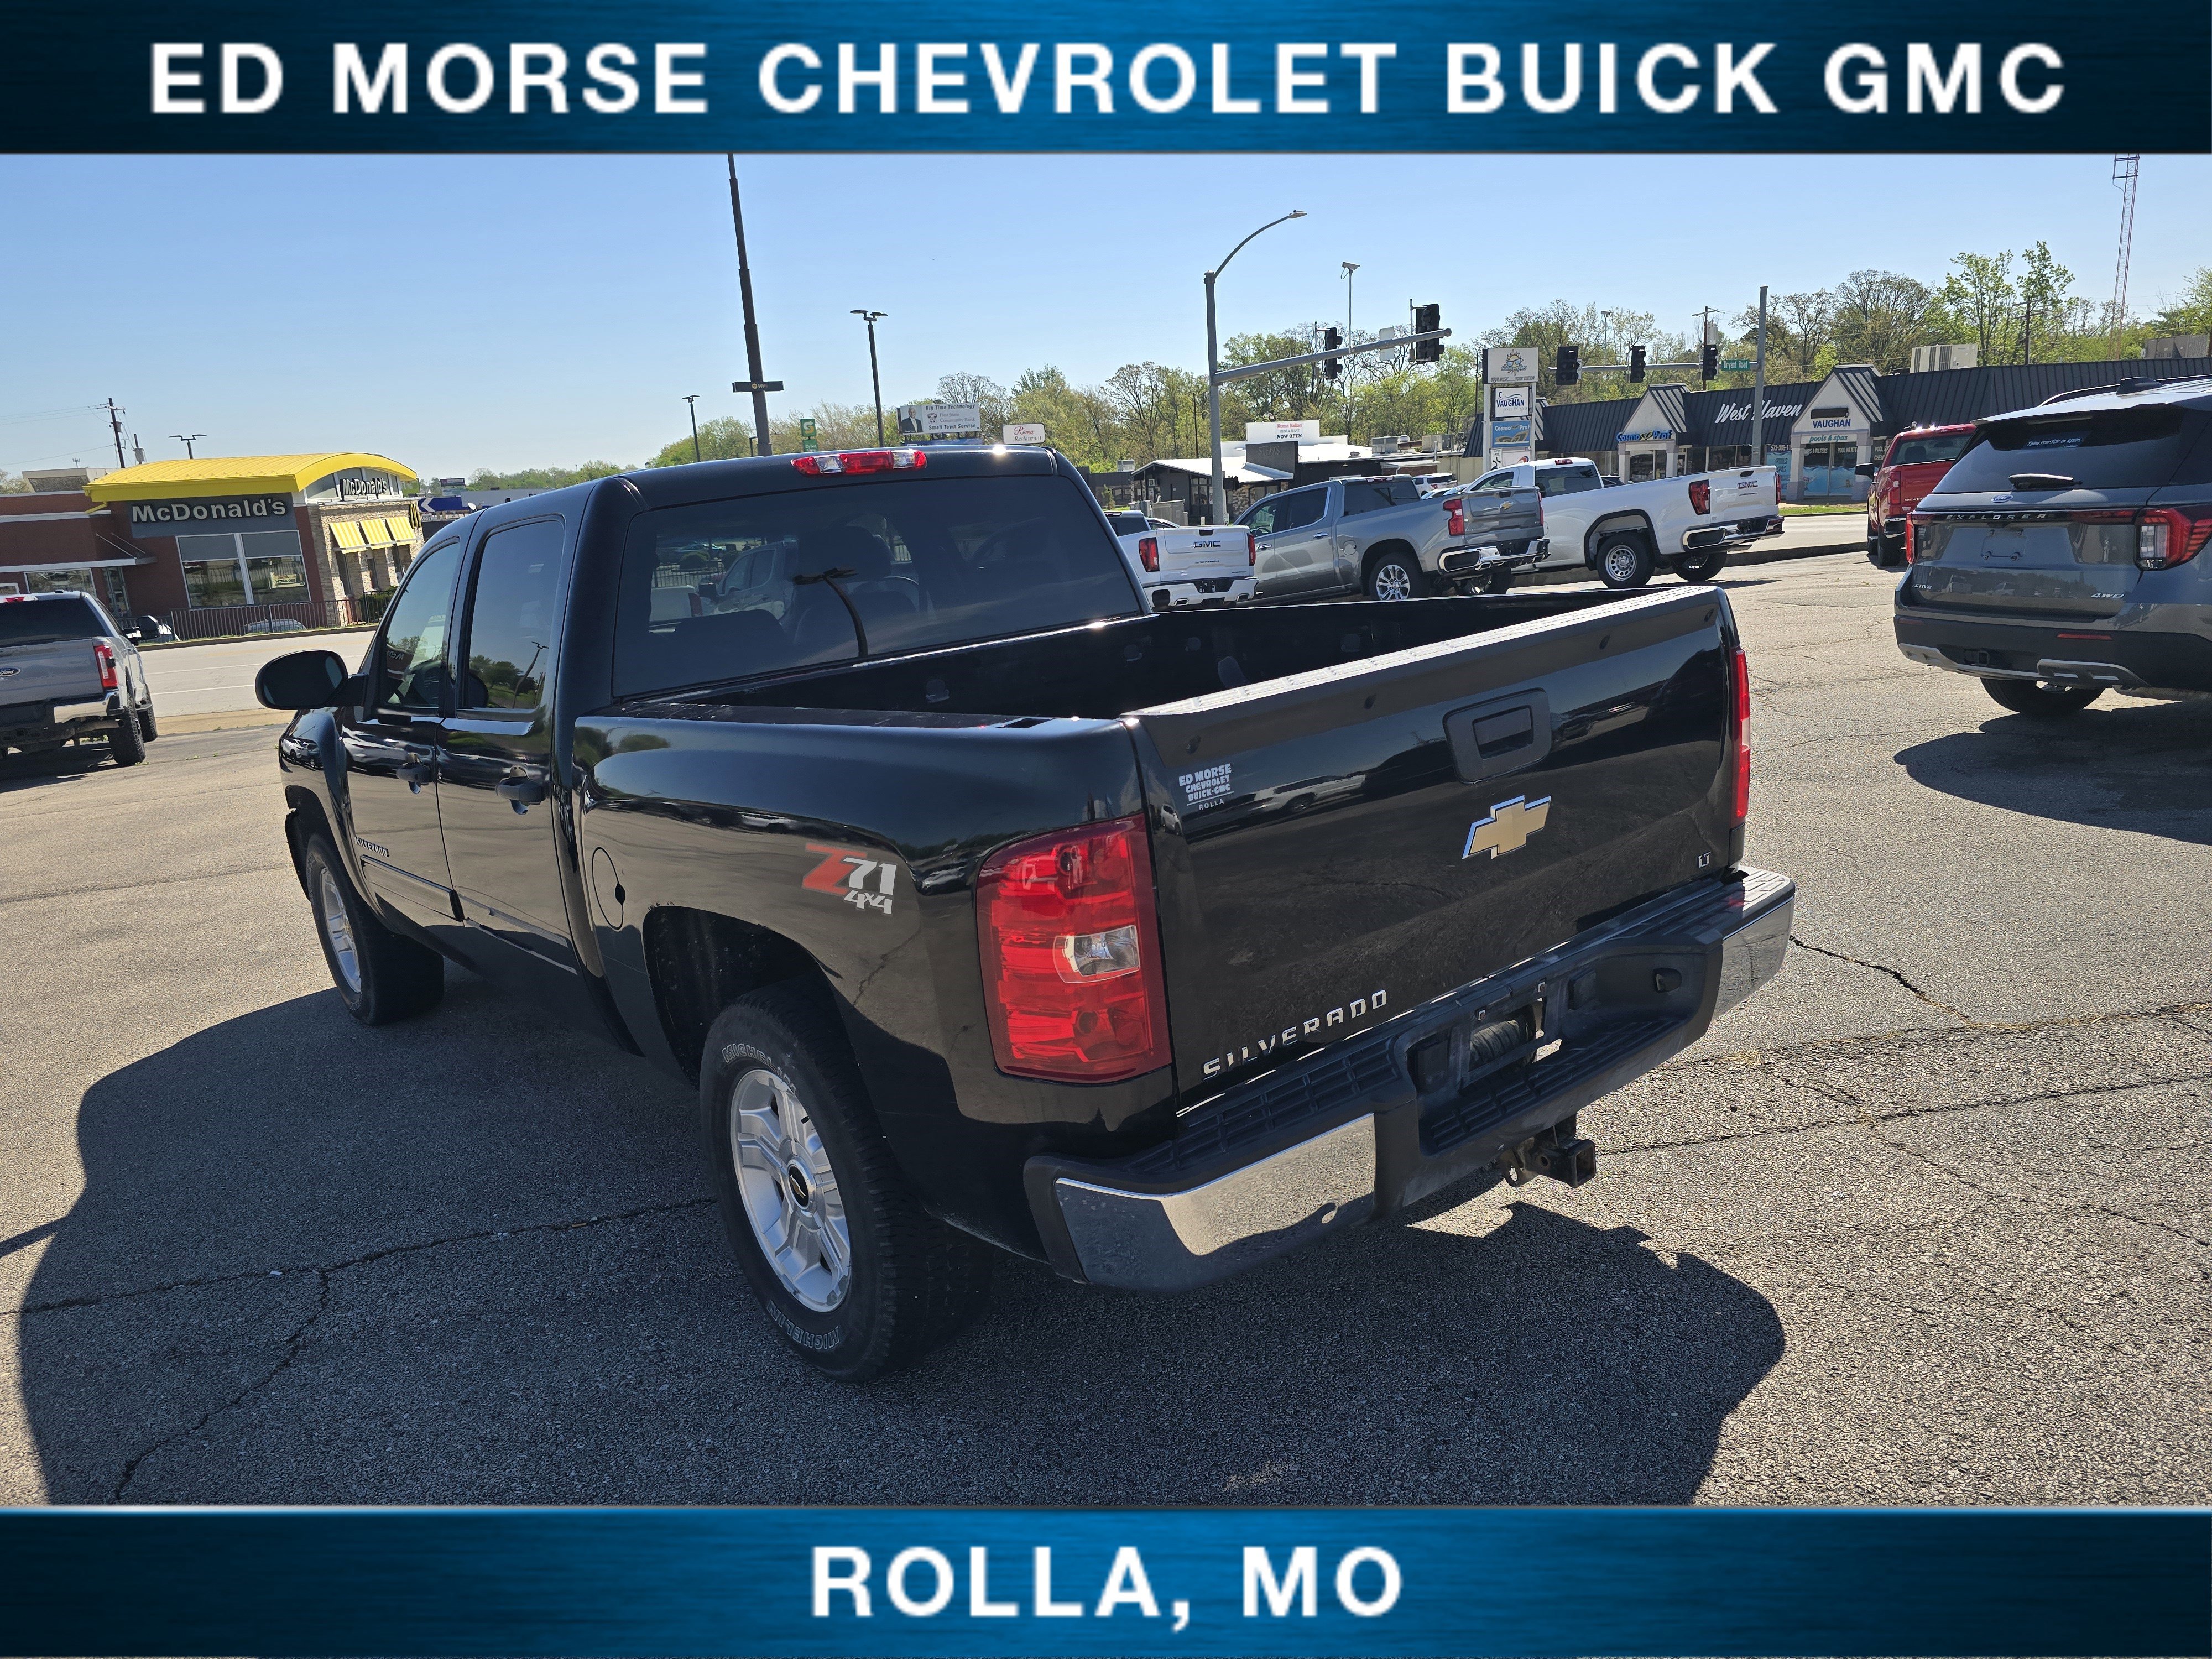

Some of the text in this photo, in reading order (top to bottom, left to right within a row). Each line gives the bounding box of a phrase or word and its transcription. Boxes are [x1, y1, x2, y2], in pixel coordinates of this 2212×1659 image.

[1724, 361, 1736, 370] Bryant
[1496, 399, 1524, 407] VAUGHAN
[1715, 403, 1752, 424] West
[1014, 426, 1034, 435] Roma
[1813, 419, 1851, 428] VAUGHAN
[1616, 430, 1672, 441] Cosmo Prof
[1809, 435, 1827, 443] pools
[341, 477, 388, 496] McDonald's
[1738, 481, 1759, 489] GMC
[132, 498, 286, 523] McDonald's
[1178, 763, 1232, 786] ED MORSE
[1186, 774, 1230, 794] CHEVROLET
[1198, 799, 1224, 810] ROLLA
[356, 837, 389, 858] SILVERADO
[1698, 851, 1712, 868] LT
[803, 843, 896, 901] Z71
[1203, 989, 1387, 1081] SILVERADO
[721, 1043, 796, 1095] MICHELIN
[766, 1299, 840, 1350] MICHELIN
